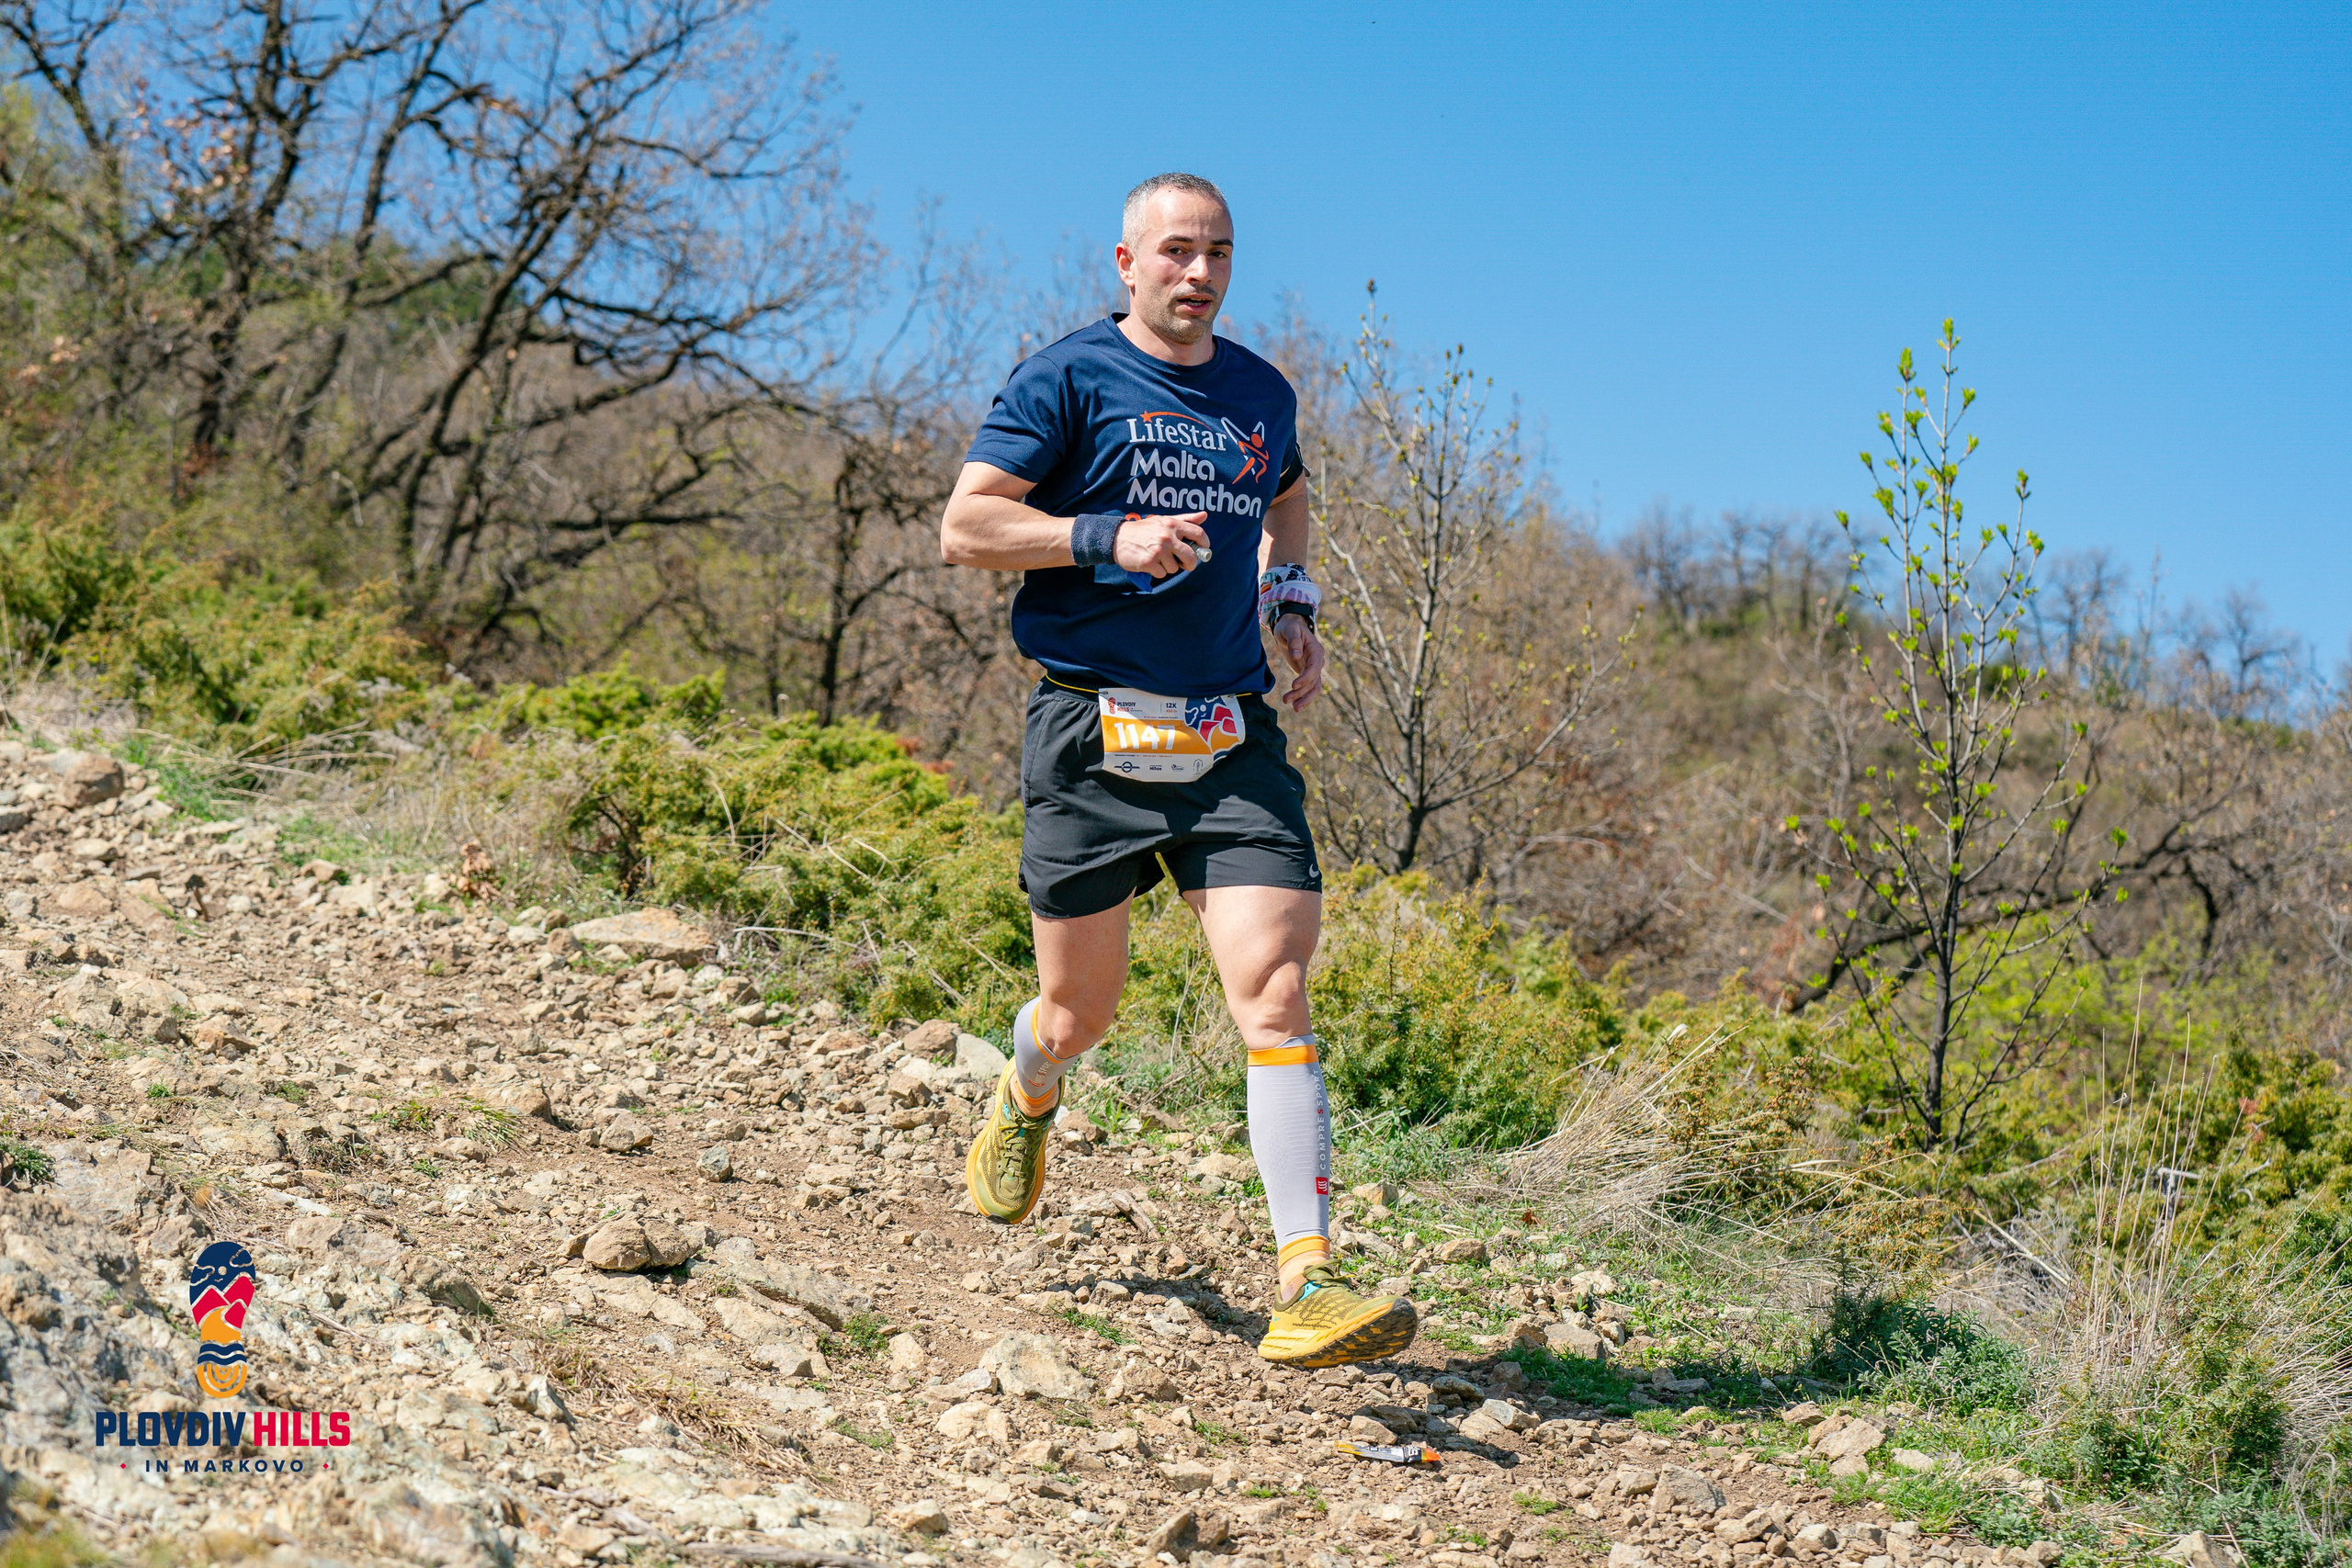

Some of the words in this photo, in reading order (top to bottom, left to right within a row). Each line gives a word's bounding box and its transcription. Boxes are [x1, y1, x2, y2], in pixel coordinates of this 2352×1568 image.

[1126, 414, 1227, 451] LifeStar
[1130, 447, 1216, 481] Malta
[1126, 478, 1262, 519] Marathon
[1114, 722, 1175, 750] 1147
[1313, 1068, 1327, 1170] COMPRESSPORT
